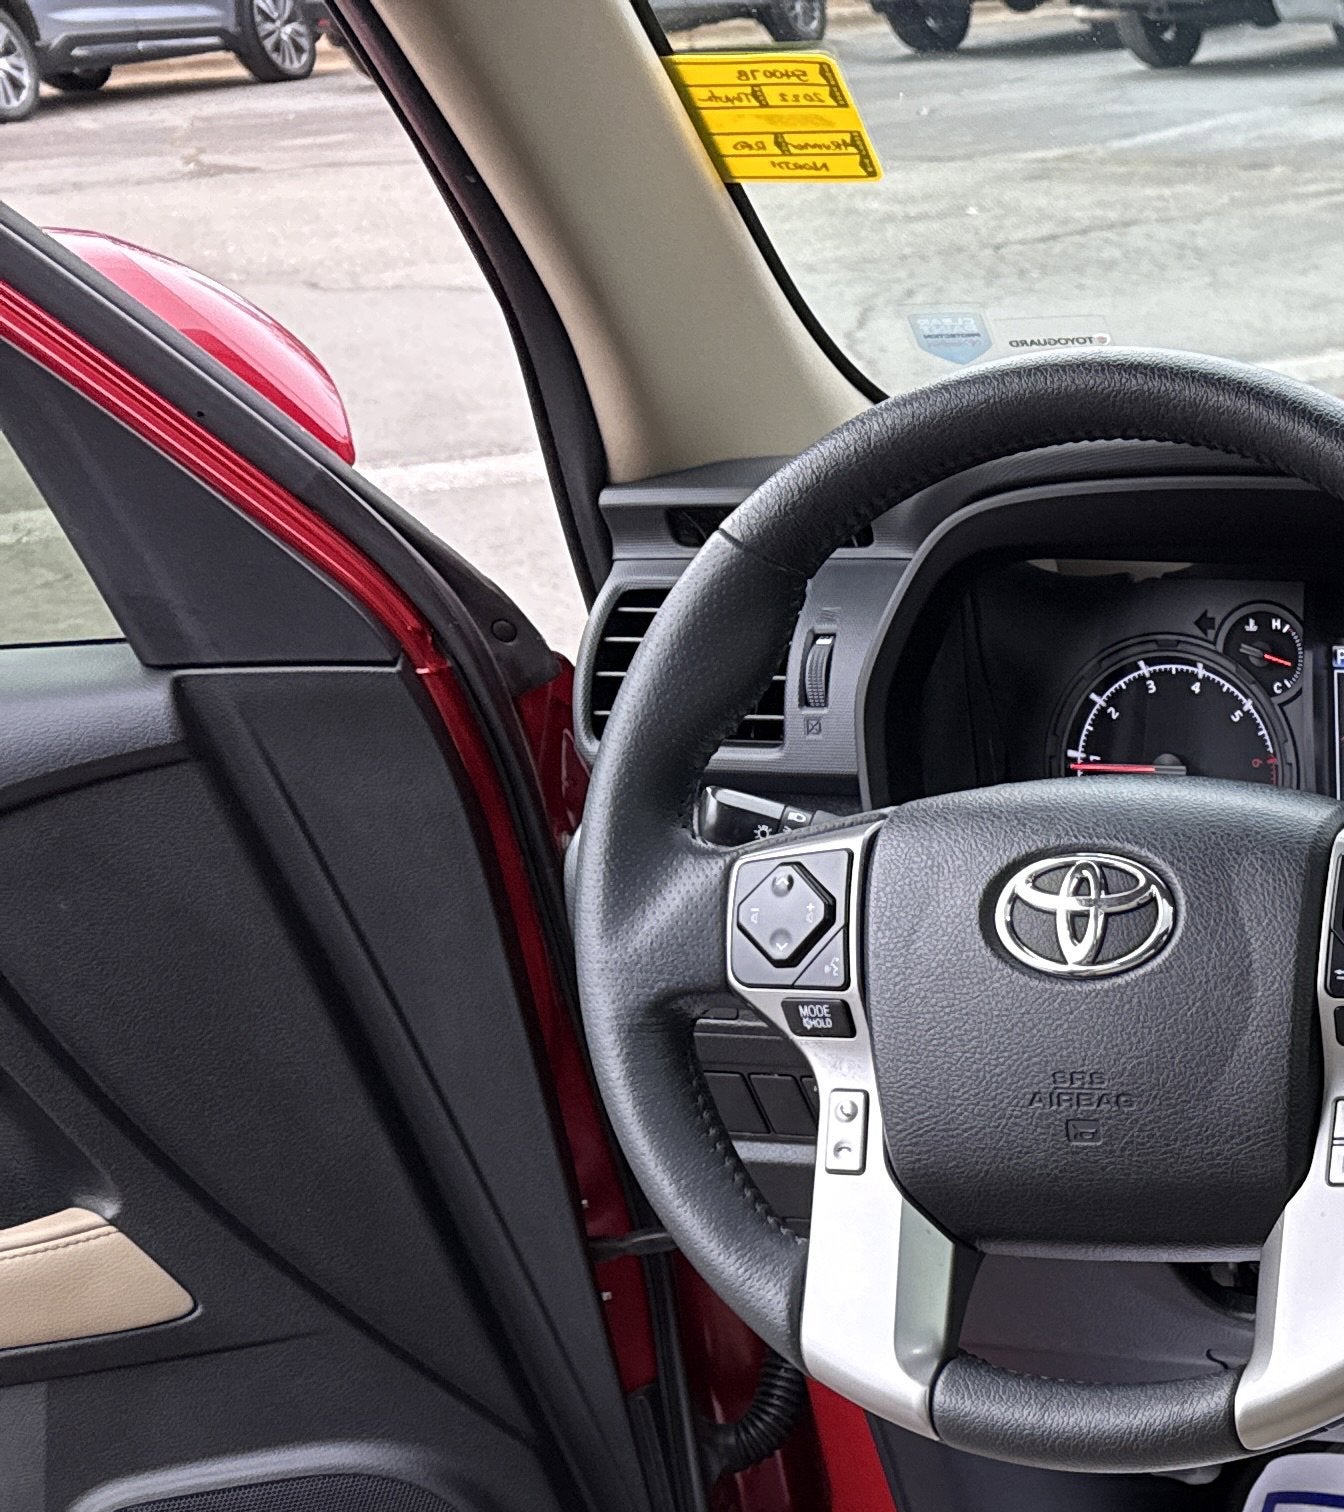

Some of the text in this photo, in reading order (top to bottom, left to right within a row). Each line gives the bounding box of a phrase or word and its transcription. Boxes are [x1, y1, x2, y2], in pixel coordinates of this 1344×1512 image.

[1271, 618, 1281, 630] H
[1146, 680, 1157, 694] 3
[1190, 682, 1201, 694] 4
[1273, 682, 1283, 694] C
[1106, 706, 1120, 720] 2
[1230, 710, 1244, 723] 5
[799, 1004, 831, 1018] MODE
[1028, 1091, 1137, 1110] AIRBAG
